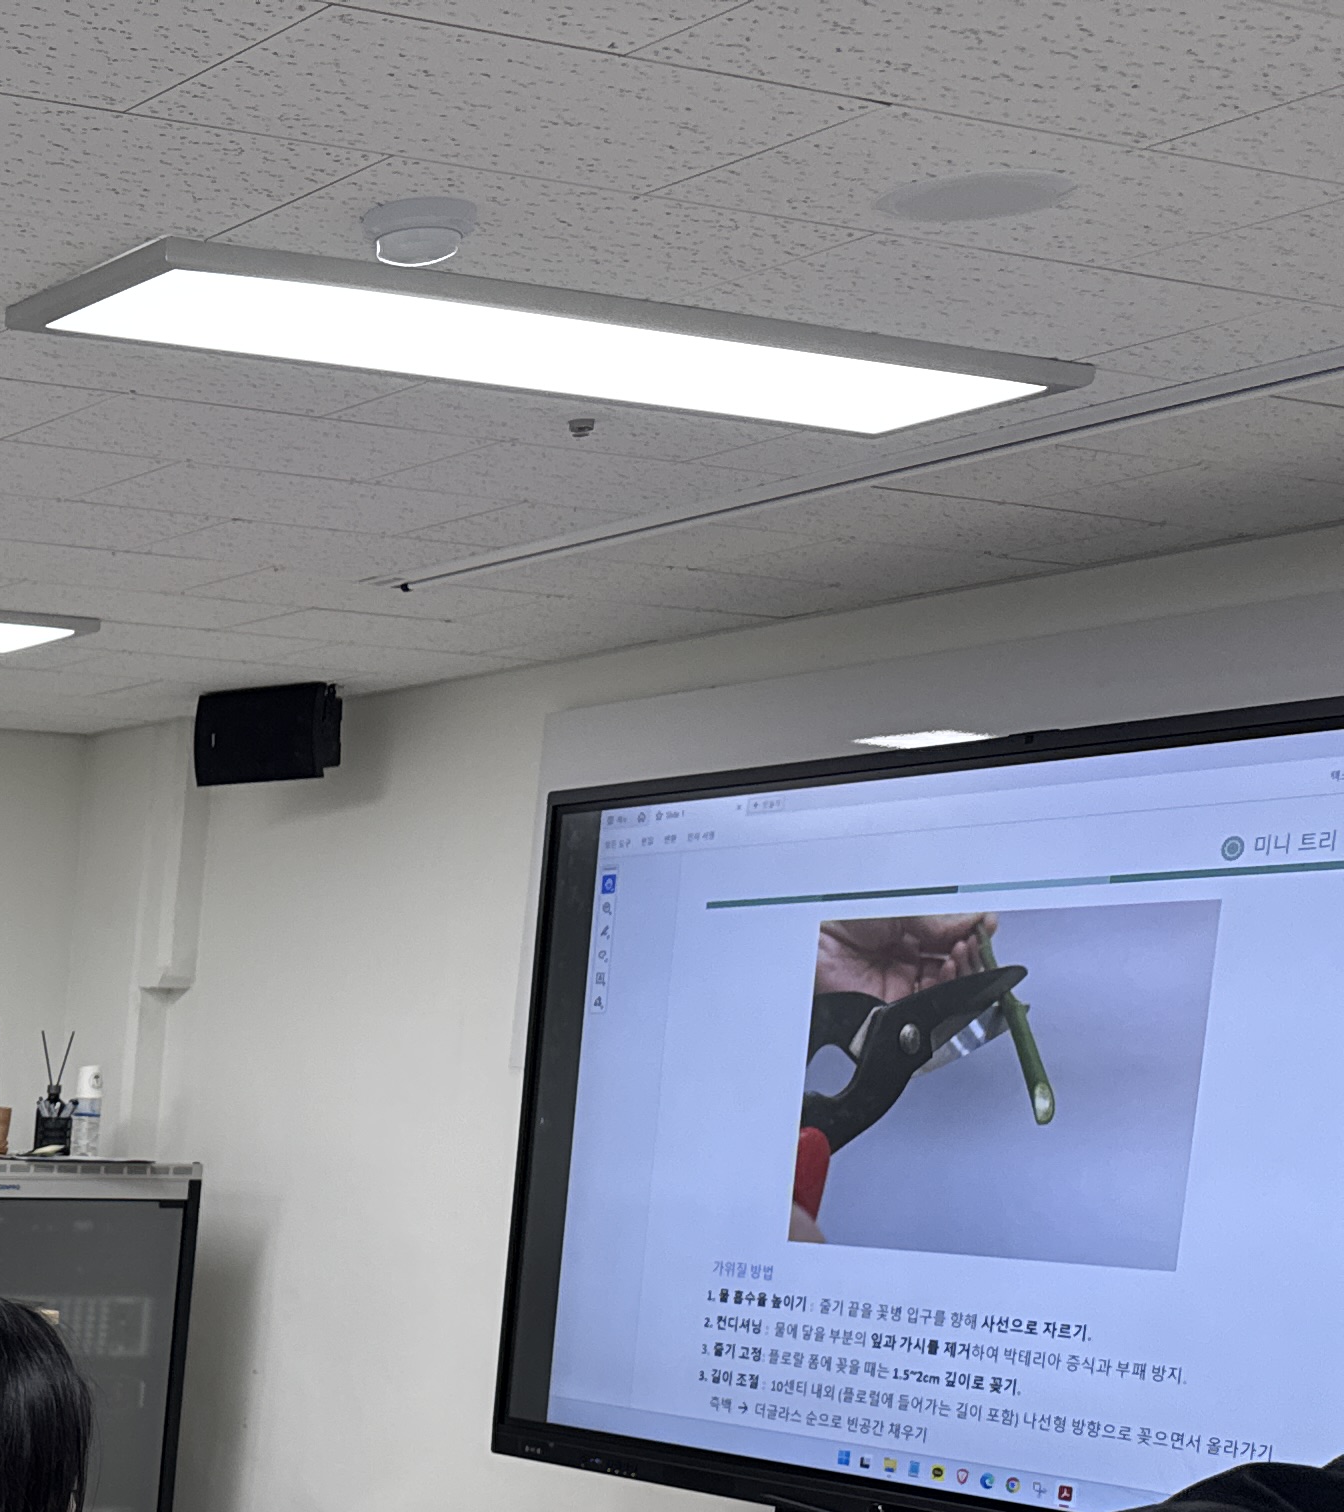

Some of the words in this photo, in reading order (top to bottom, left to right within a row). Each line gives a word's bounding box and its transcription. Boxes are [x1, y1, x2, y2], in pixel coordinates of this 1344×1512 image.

[1254, 833, 1291, 855] 미니
[1298, 829, 1337, 852] 트리
[712, 1260, 747, 1279] 가위질
[750, 1265, 774, 1281] 방법
[707, 1289, 716, 1302] 1.
[719, 1288, 729, 1303] 물
[771, 1293, 807, 1311] 높이기
[819, 1298, 844, 1316] 줄기
[848, 1302, 872, 1319] 끝을
[907, 1307, 946, 1327] 입구를
[951, 1311, 977, 1330] 향해
[981, 1315, 1038, 1335] 사선으로
[1043, 1321, 1092, 1342] 자르기.
[704, 1317, 713, 1328] 2.
[716, 1316, 762, 1334] 컨디셔닝
[775, 1321, 797, 1340] 물에
[829, 1329, 866, 1347] 부분의
[871, 1333, 896, 1350] 잎과
[900, 1336, 939, 1355] 가시를
[944, 1342, 999, 1363] 제거하여
[1004, 1348, 1062, 1370] 박테리아
[1066, 1354, 1112, 1376] 증식과
[1116, 1360, 1147, 1381] 부패
[1152, 1364, 1187, 1385] 방지.
[713, 1342, 737, 1359] 줄기
[809, 1353, 832, 1372] 폼에
[864, 1361, 889, 1379] 때는
[893, 1367, 940, 1385] 1.5~2cm
[945, 1371, 985, 1391] 깊이로
[699, 1370, 707, 1382] 3.
[711, 1368, 733, 1385] 길이
[736, 1372, 759, 1389] 조절
[771, 1379, 807, 1397] 10센티
[811, 1383, 835, 1401] 내외
[898, 1393, 951, 1417] 들어가는
[956, 1402, 982, 1421] 길이
[986, 1407, 1019, 1428] 포함)
[1023, 1412, 1067, 1433] 나선형
[1071, 1418, 1132, 1442] 방향으로
[1207, 1437, 1273, 1462] 올라가기
[755, 1402, 802, 1423] 더글라스
[806, 1410, 842, 1429] 순으로
[847, 1416, 884, 1437] 빈공간
[888, 1422, 927, 1443] 채우기
